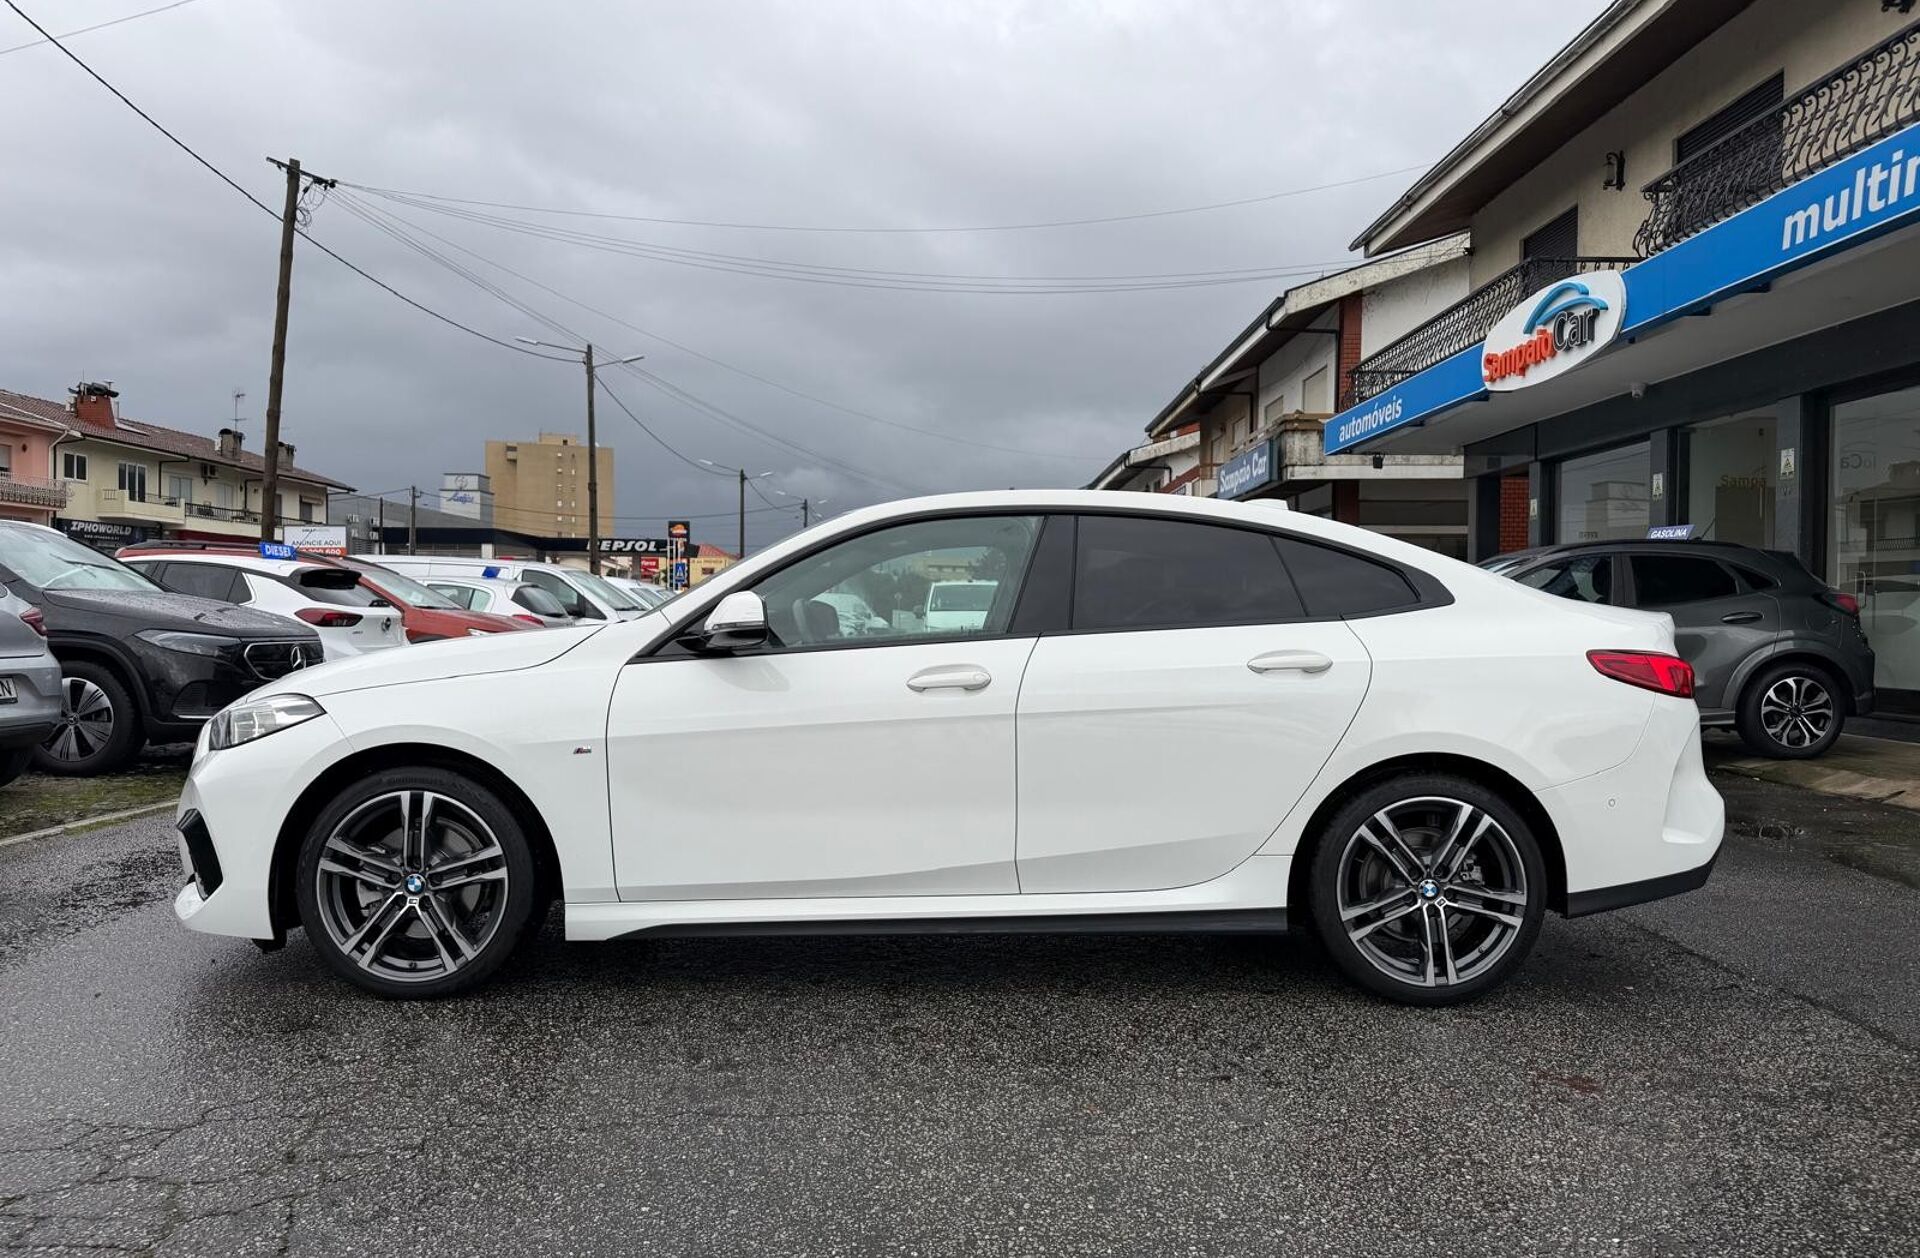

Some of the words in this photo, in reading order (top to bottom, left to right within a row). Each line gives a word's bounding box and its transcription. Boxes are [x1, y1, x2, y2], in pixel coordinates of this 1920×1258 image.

[1338, 394, 1403, 442] automóveis
[1220, 458, 1251, 494] Sampaio
[1252, 451, 1267, 478] Car
[1650, 528, 1687, 539] GASOLINA
